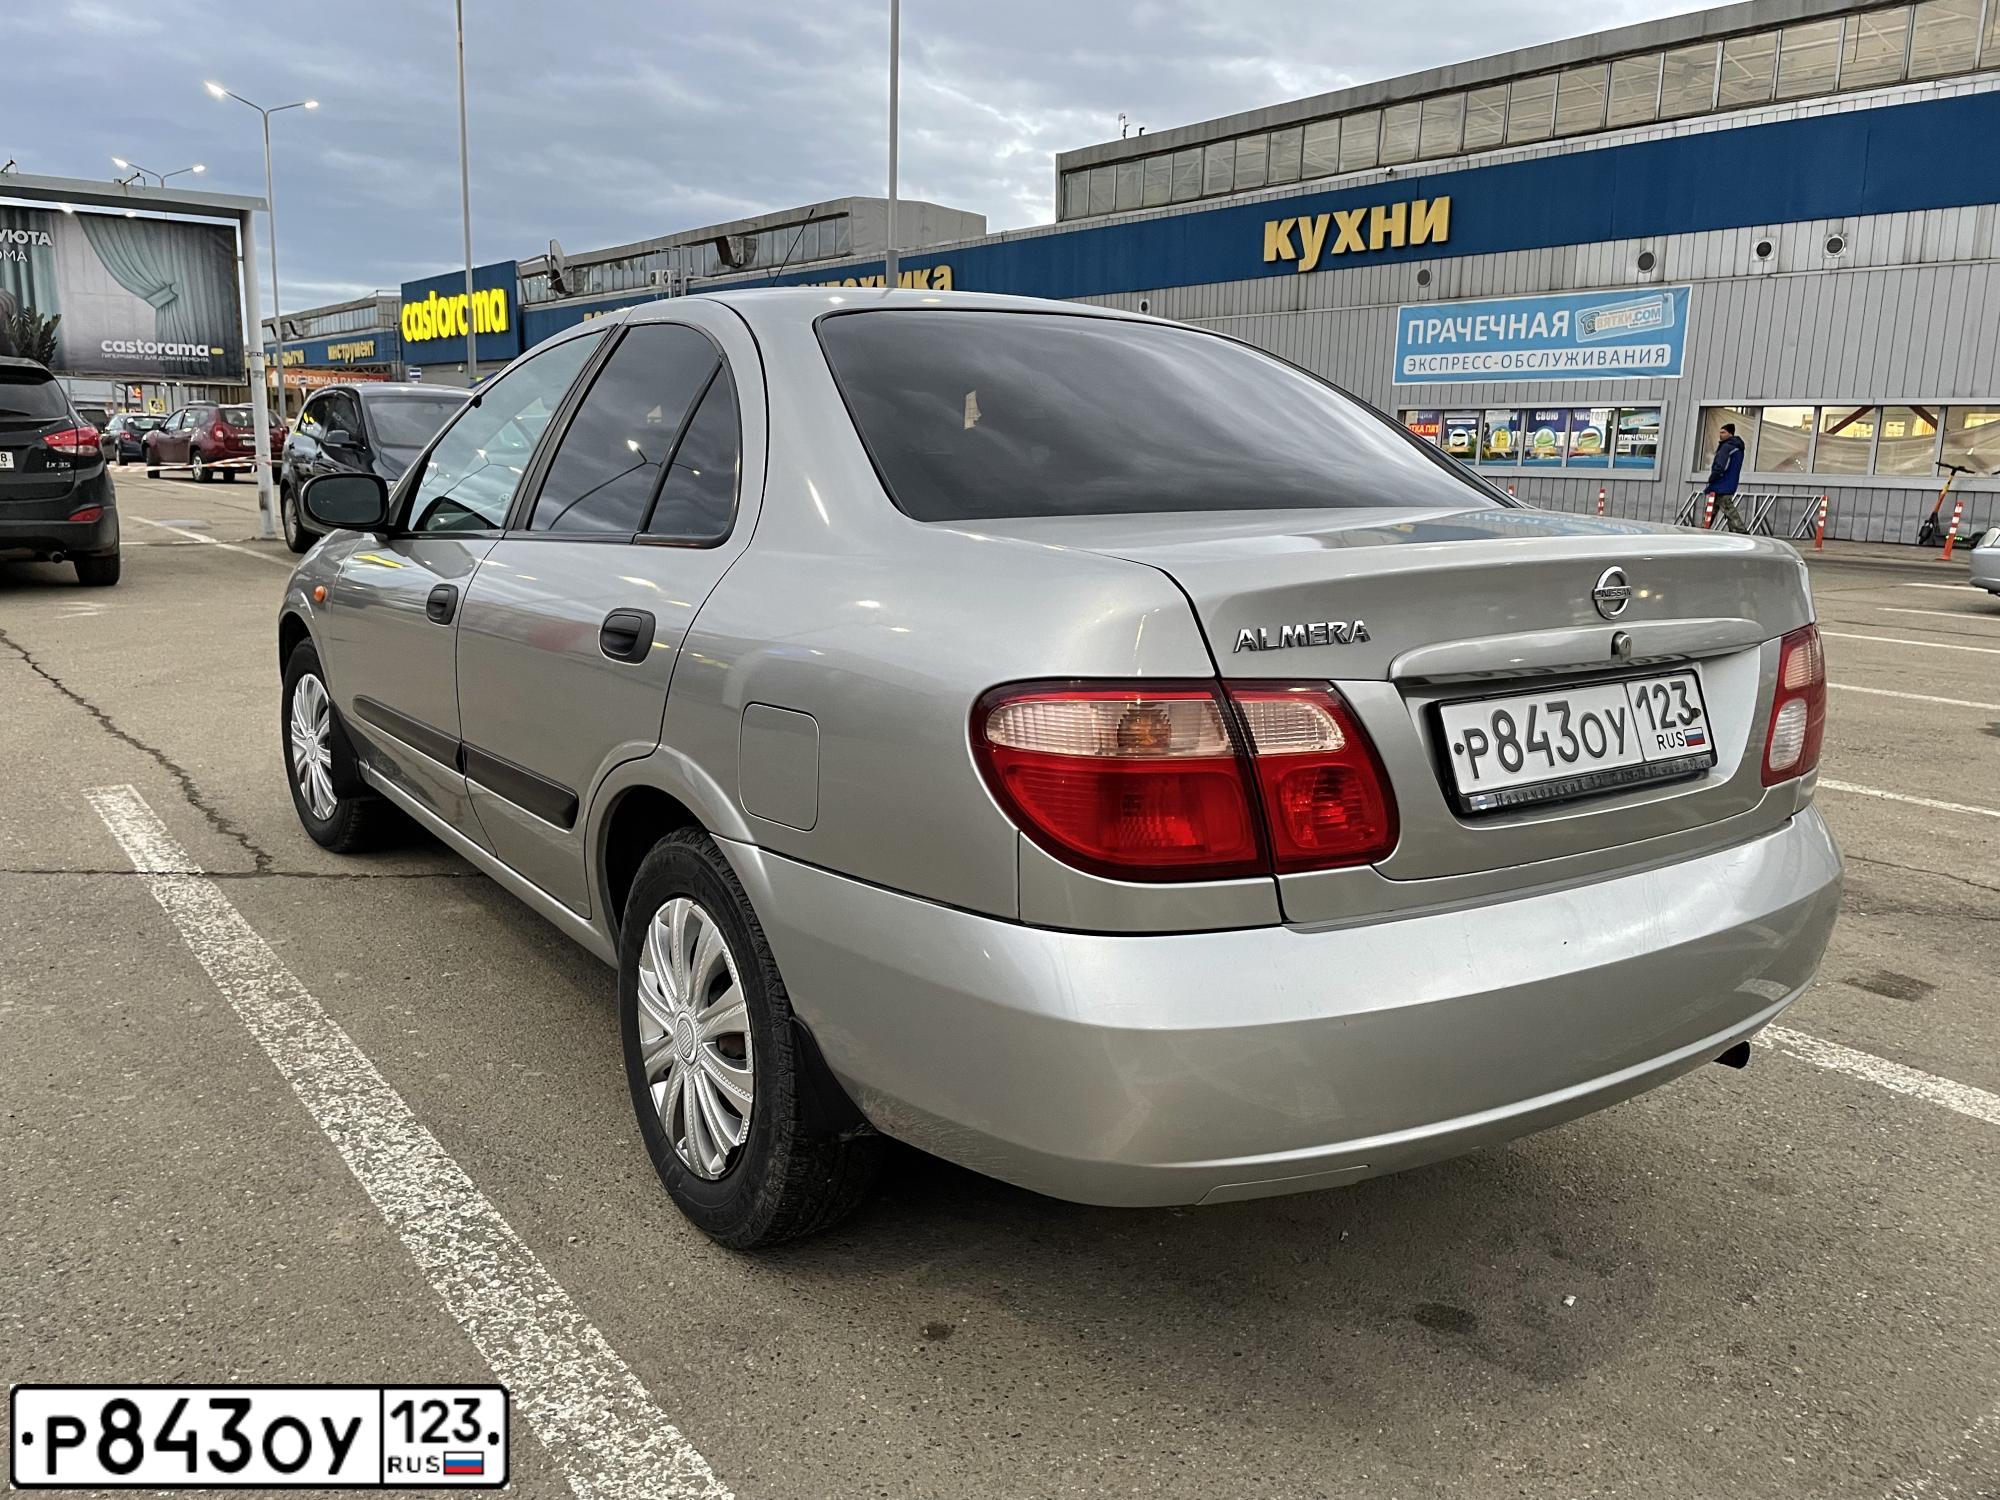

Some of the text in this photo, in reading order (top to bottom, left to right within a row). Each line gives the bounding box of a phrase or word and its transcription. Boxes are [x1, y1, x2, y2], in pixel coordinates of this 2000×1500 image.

[1407, 310, 1570, 345] ПРАЧЕЧНАЯ
[101, 339, 209, 356] castorama
[1408, 347, 1667, 372] ЭКСПРЕСС-ОБСЛУЖИВАНИЯ
[1600, 588, 1632, 598] NISSAN
[1233, 619, 1371, 653] ALMERA
[1636, 680, 1694, 731] 123
[1656, 731, 1685, 750] RUS
